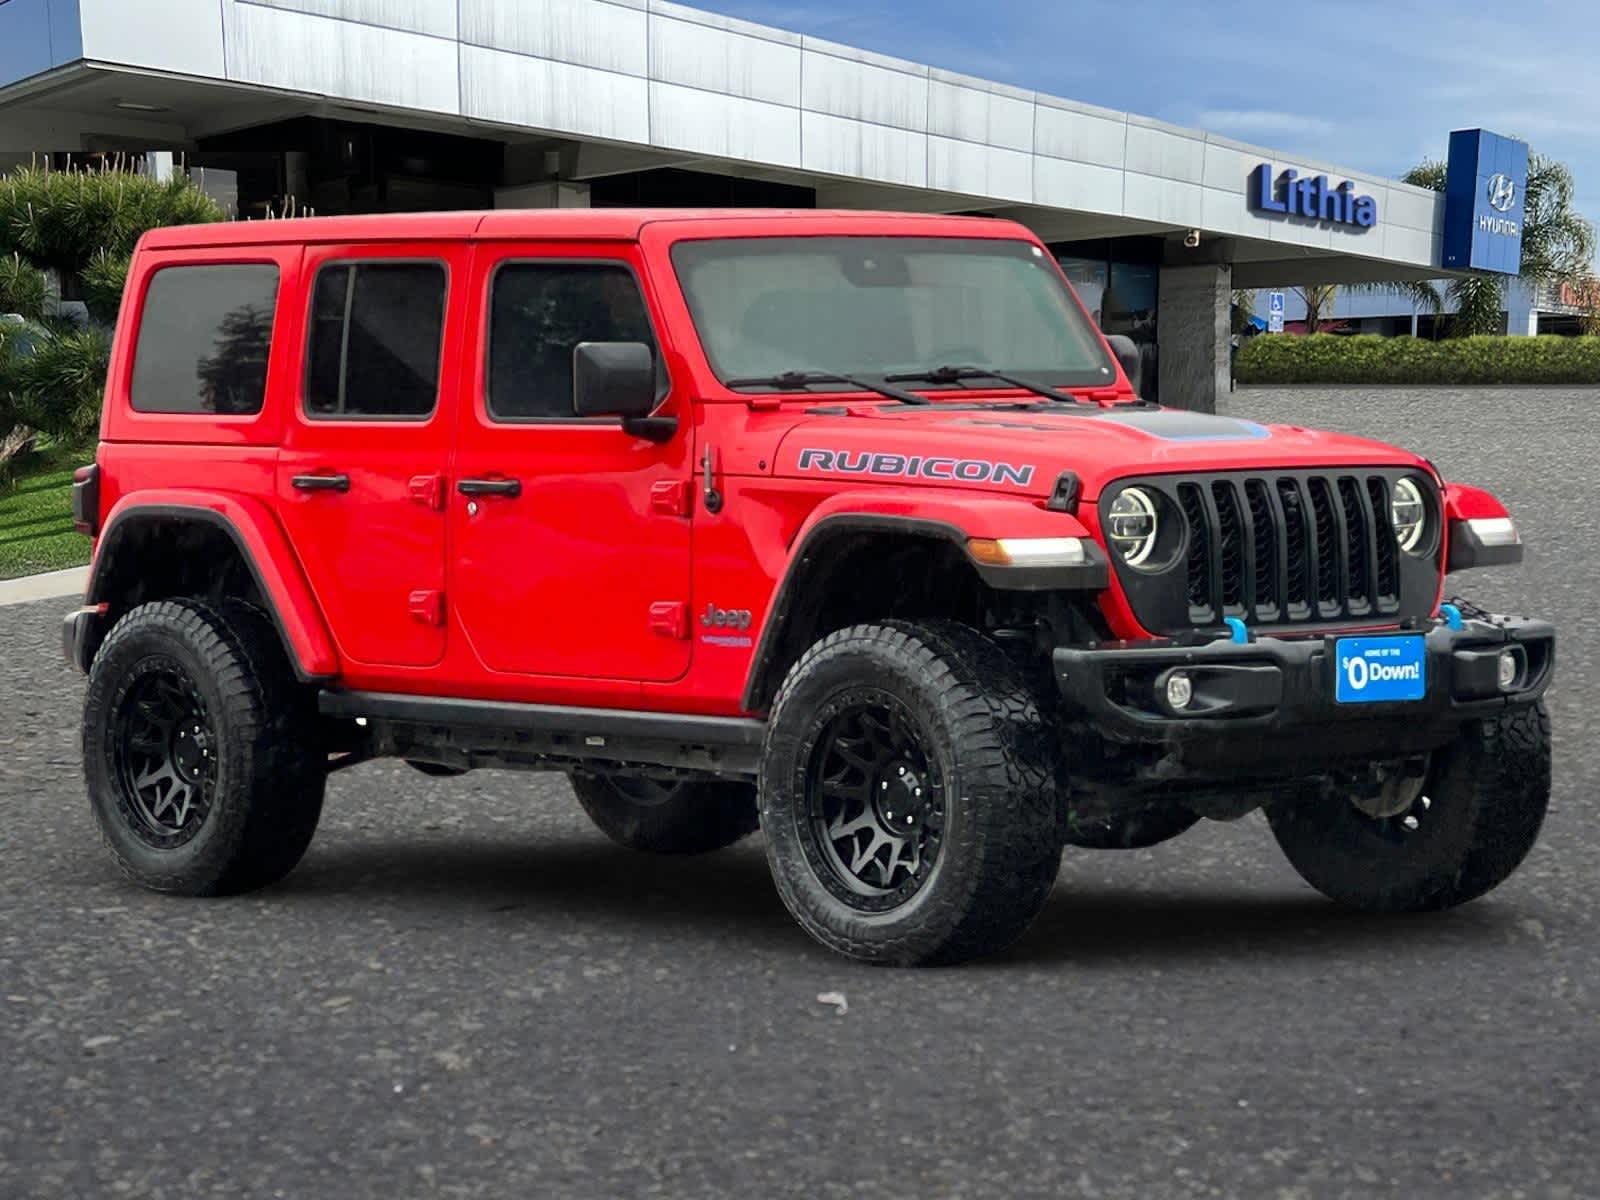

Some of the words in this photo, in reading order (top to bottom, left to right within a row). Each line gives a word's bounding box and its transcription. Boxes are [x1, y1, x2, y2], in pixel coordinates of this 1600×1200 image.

[1249, 163, 1377, 230] Lithia
[1479, 215, 1520, 238] HYUNDAI
[798, 448, 1036, 487] RUBICON
[700, 602, 752, 631] Jeep
[1369, 661, 1420, 681] Down!
